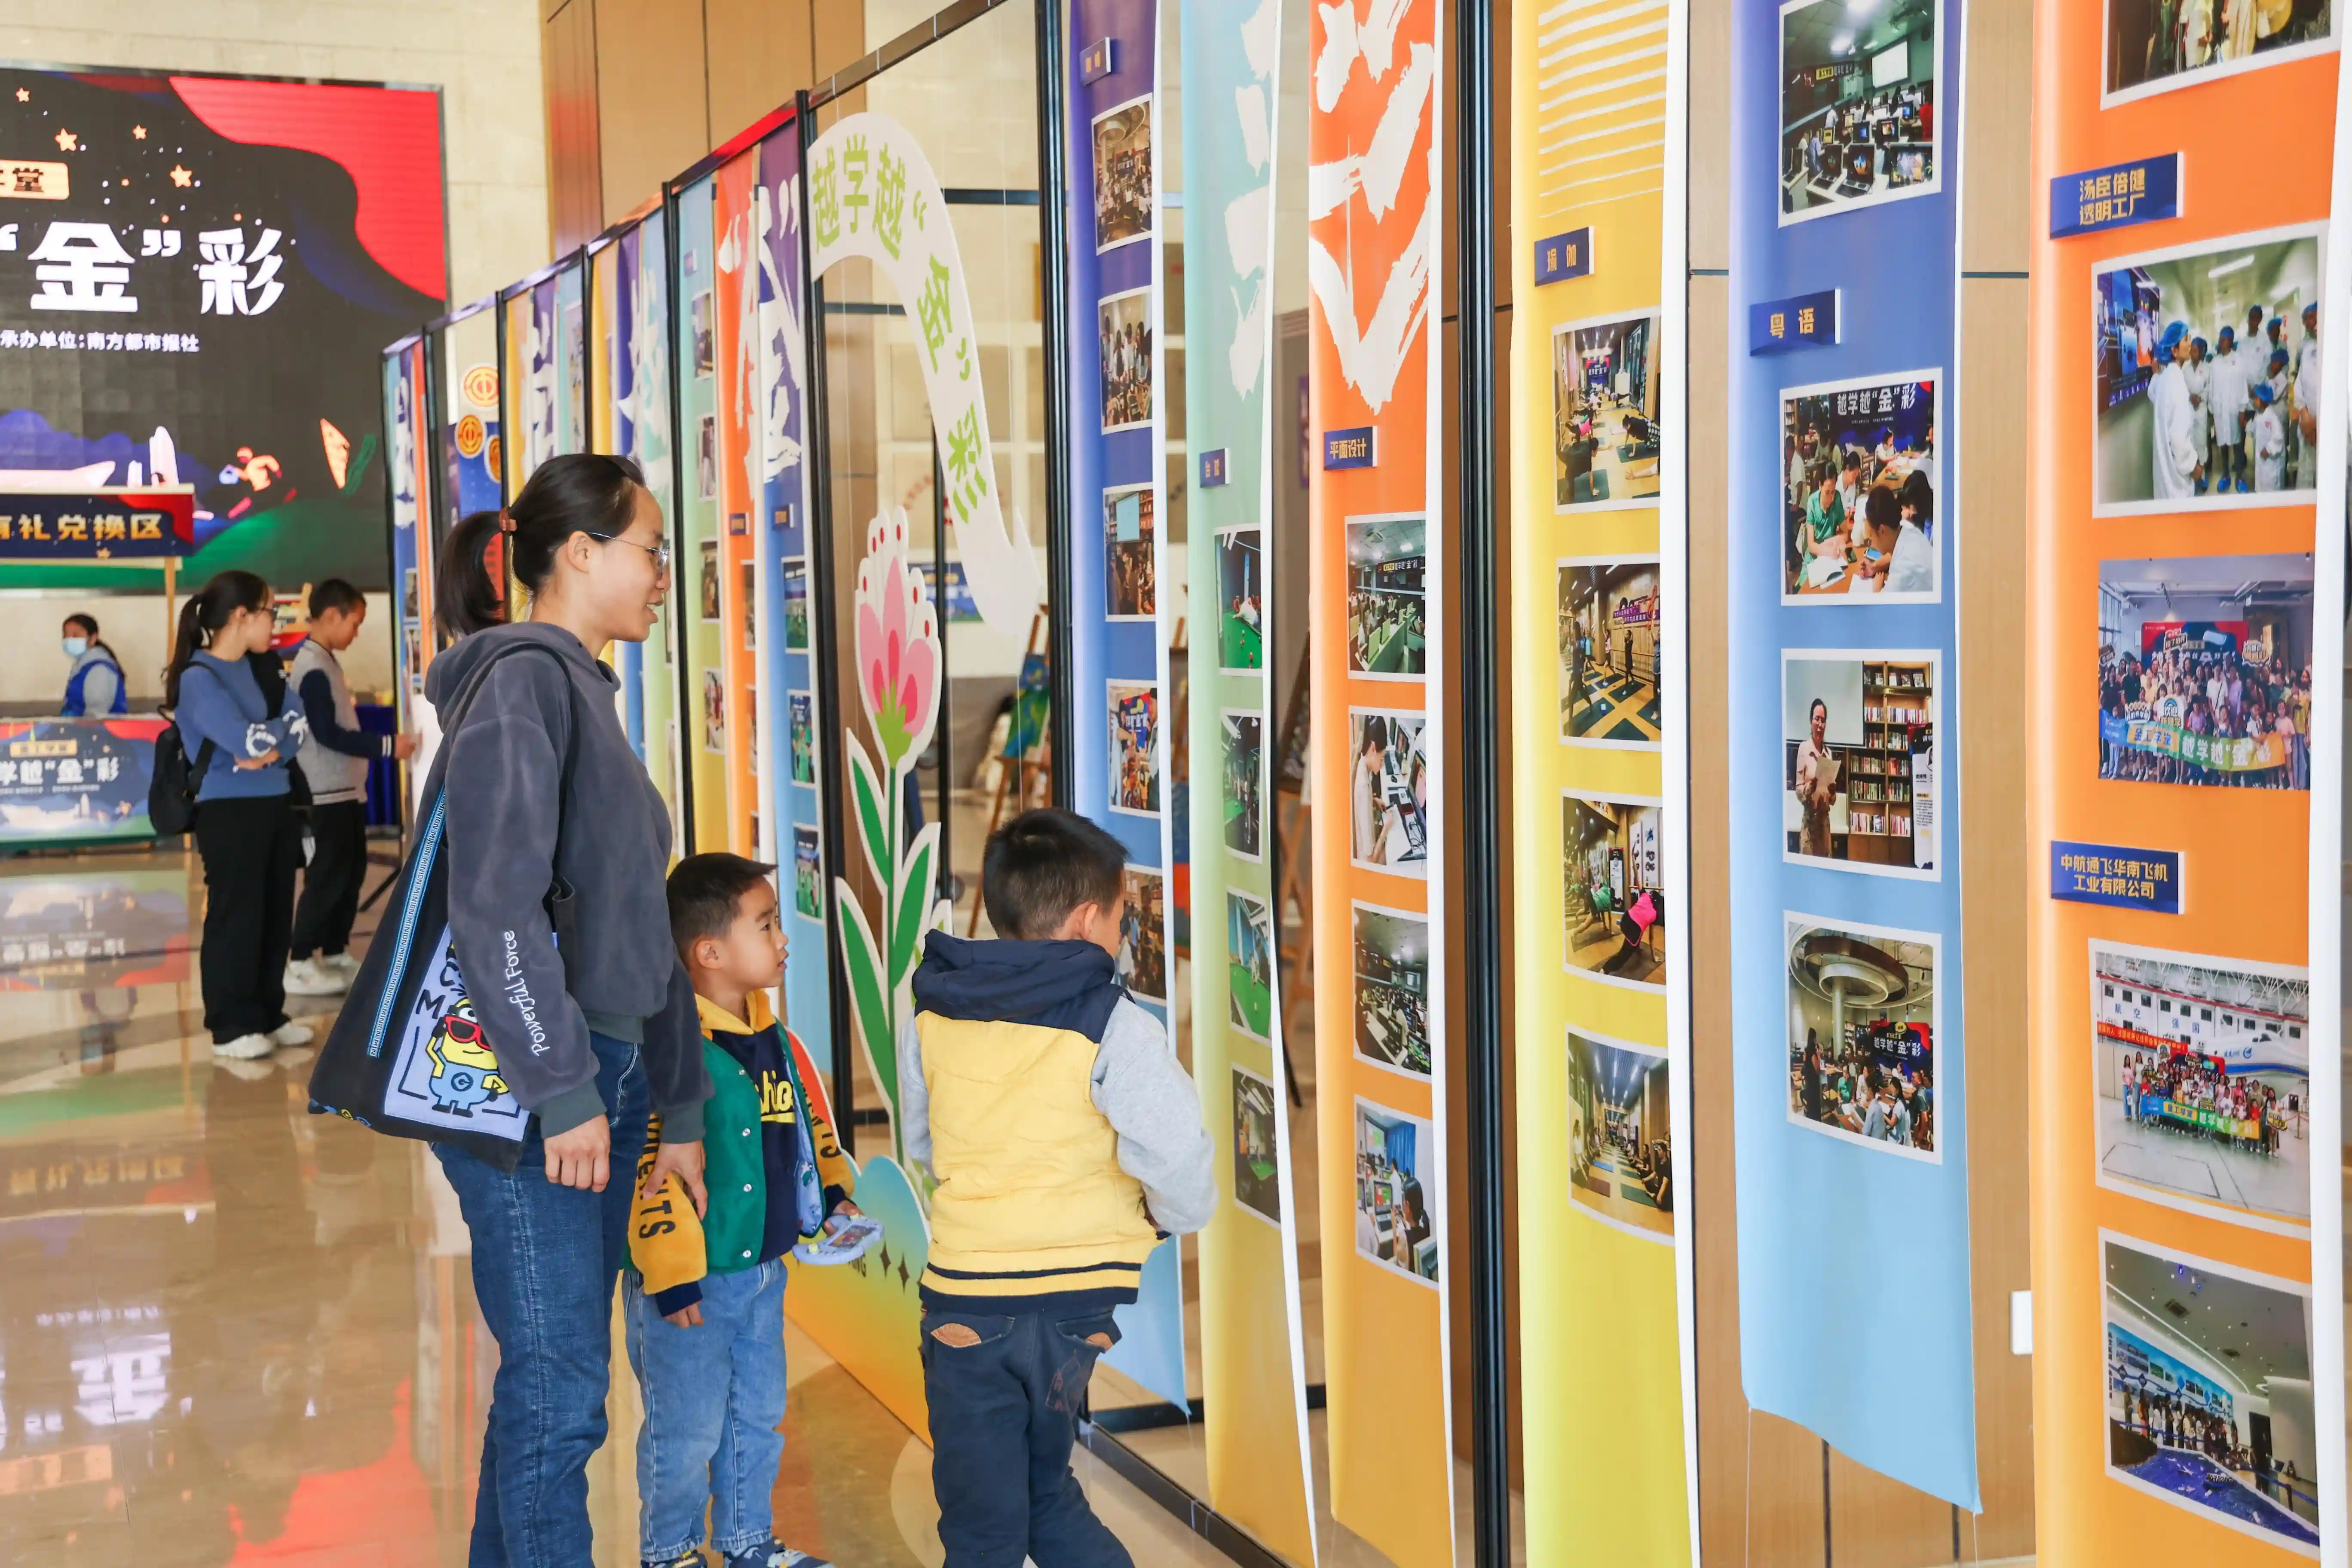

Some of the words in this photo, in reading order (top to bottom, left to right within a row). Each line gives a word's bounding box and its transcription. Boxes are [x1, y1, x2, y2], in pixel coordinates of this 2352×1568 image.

[2079, 167, 2145, 202] 汤臣倍健
[2079, 194, 2145, 225] 透明工厂
[1547, 244, 1577, 272] 瑜伽
[1770, 307, 1814, 339] 粤语
[1329, 436, 1367, 460] 平面设计
[2061, 854, 2168, 882] 中航通飞华南飞机
[2073, 875, 2155, 900] 工业有限公司
[504, 930, 523, 981] Force
